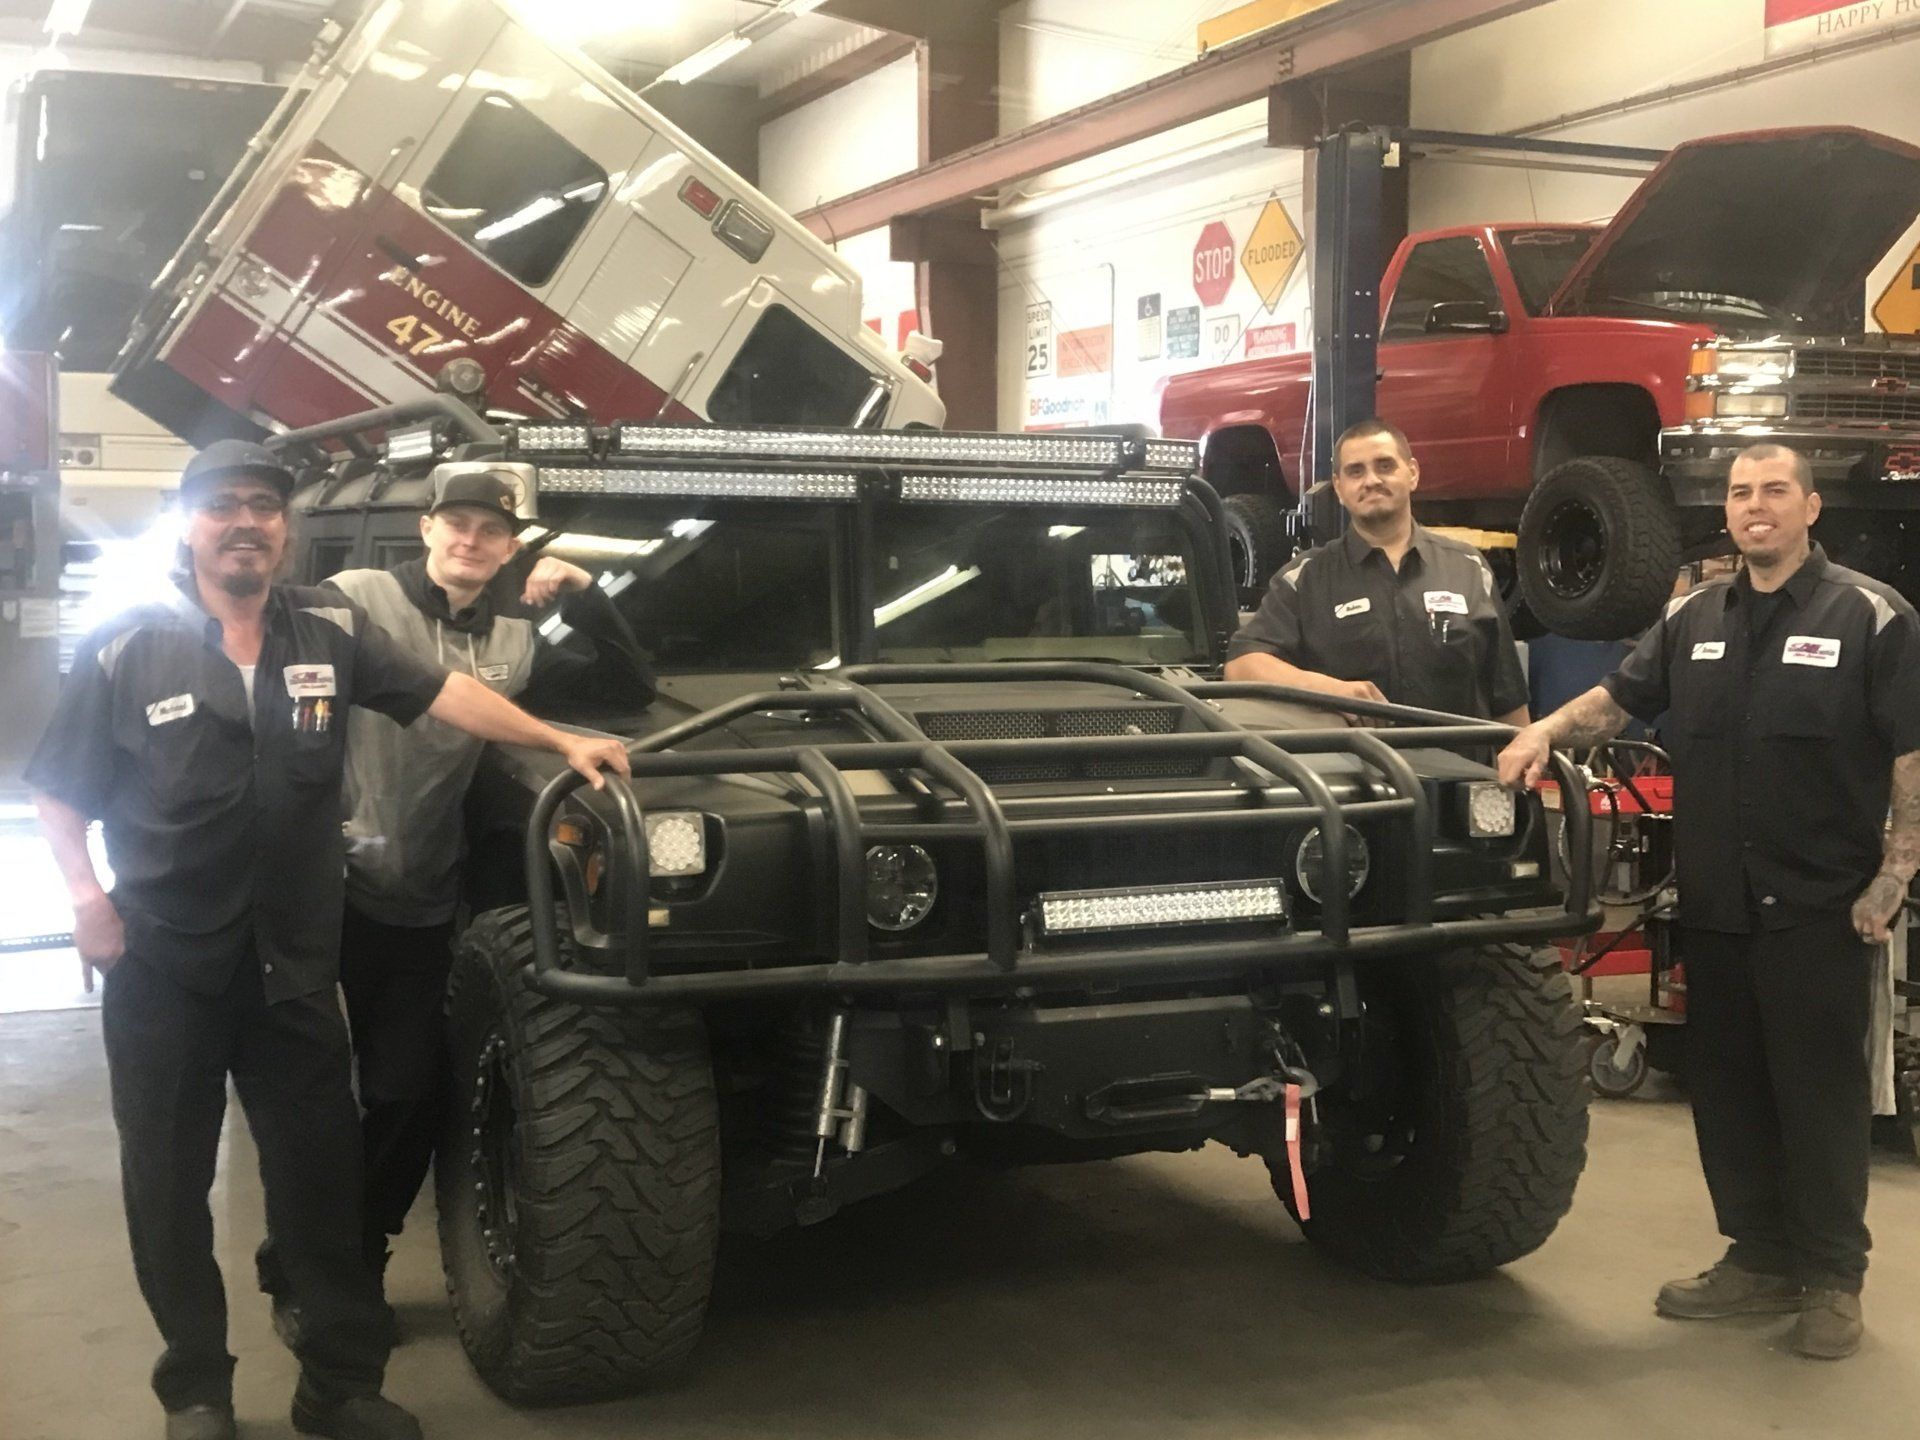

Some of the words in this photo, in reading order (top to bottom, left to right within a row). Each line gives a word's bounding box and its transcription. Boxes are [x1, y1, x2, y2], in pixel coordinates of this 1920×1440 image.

[1817, 1, 1884, 35] HAPPY
[1195, 246, 1232, 284] STOP
[1248, 241, 1296, 265] FLOODED
[389, 265, 481, 338] ENGINE
[1027, 308, 1050, 324] SPEED
[386, 315, 444, 356] 47
[1029, 326, 1048, 340] LIMIT
[1214, 324, 1230, 344] DO
[1027, 343, 1048, 372] 25
